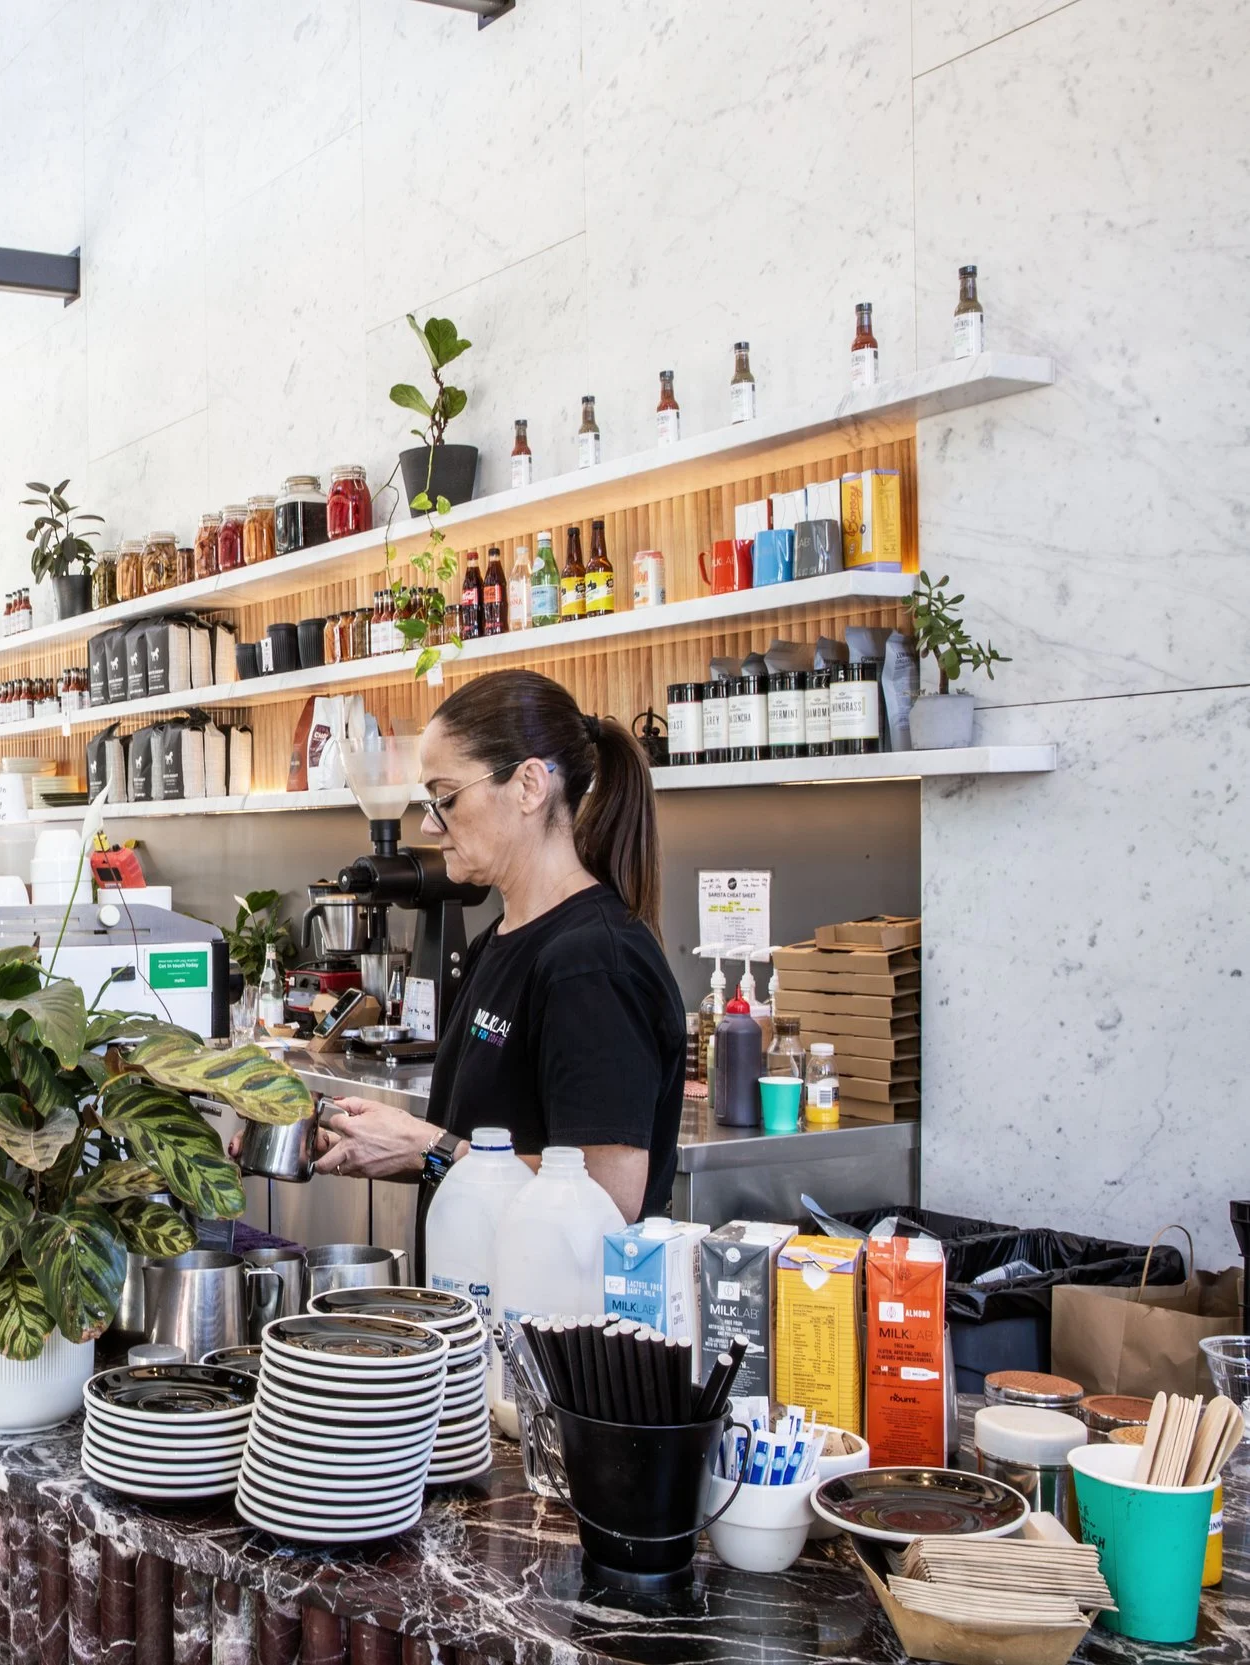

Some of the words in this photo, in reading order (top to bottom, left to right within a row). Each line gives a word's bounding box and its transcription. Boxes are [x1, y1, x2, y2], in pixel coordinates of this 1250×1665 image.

[627, 1280, 648, 1289] LACTOSE
[627, 1287, 641, 1295] DAIRY
[905, 1309, 930, 1318] ALMOND
[742, 1328, 760, 1336] FLAVOURS
[879, 1327, 934, 1341] MILKLAB
